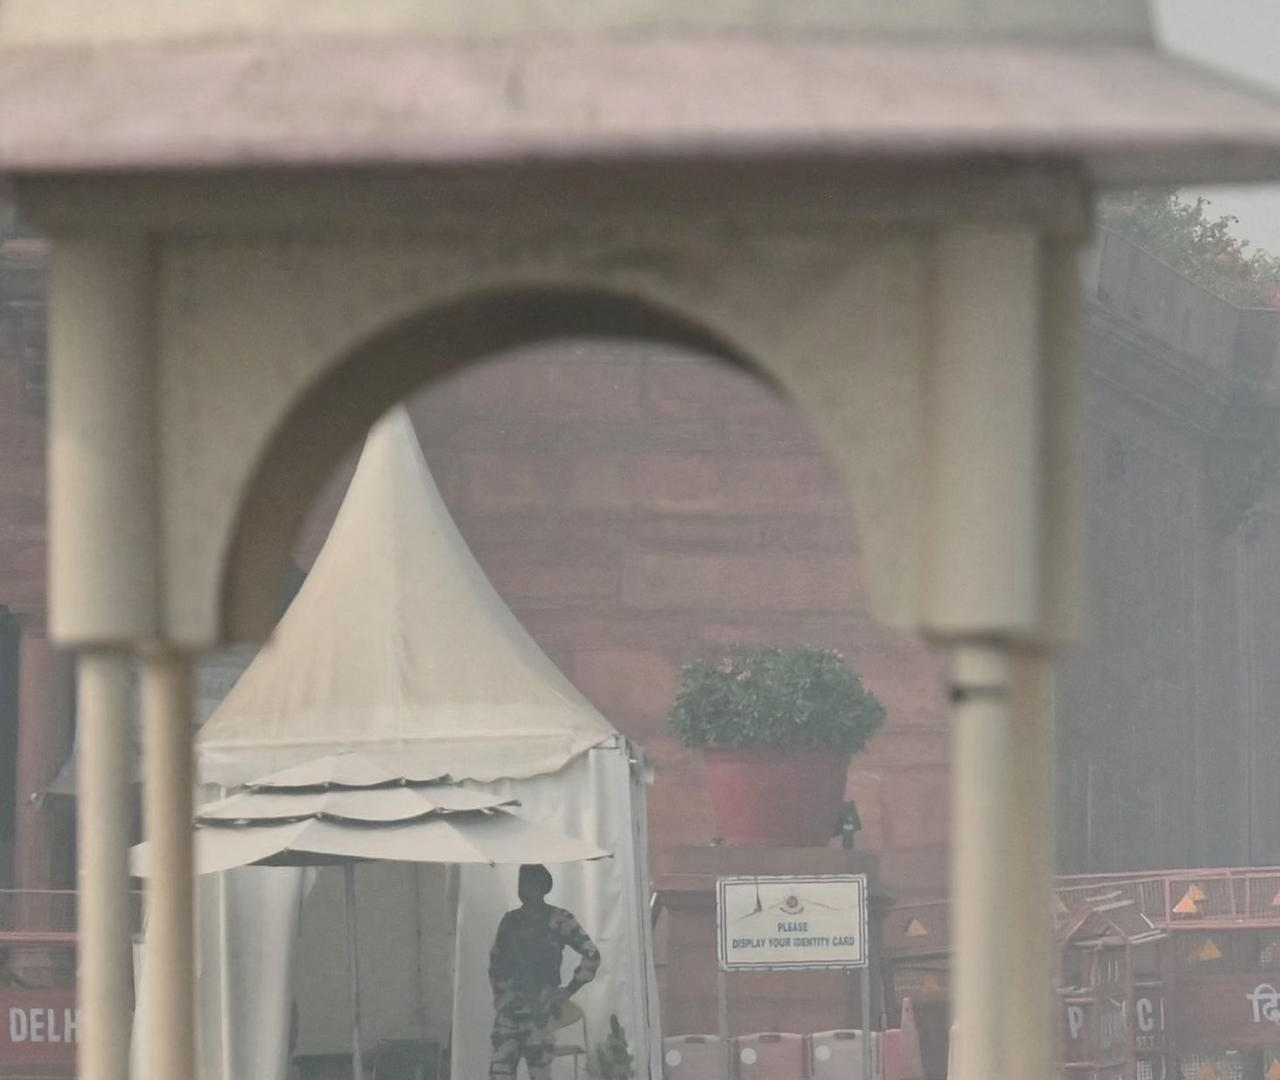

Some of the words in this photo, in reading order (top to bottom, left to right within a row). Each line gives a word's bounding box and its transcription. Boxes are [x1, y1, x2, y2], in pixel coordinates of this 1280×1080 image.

[777, 922, 808, 932] PLEASE
[732, 938, 766, 949] DISPLAY
[768, 937, 791, 948] YOUR
[792, 936, 830, 947] IDENTITY
[832, 936, 855, 946] CARD
[9, 1007, 80, 1043] DELH
